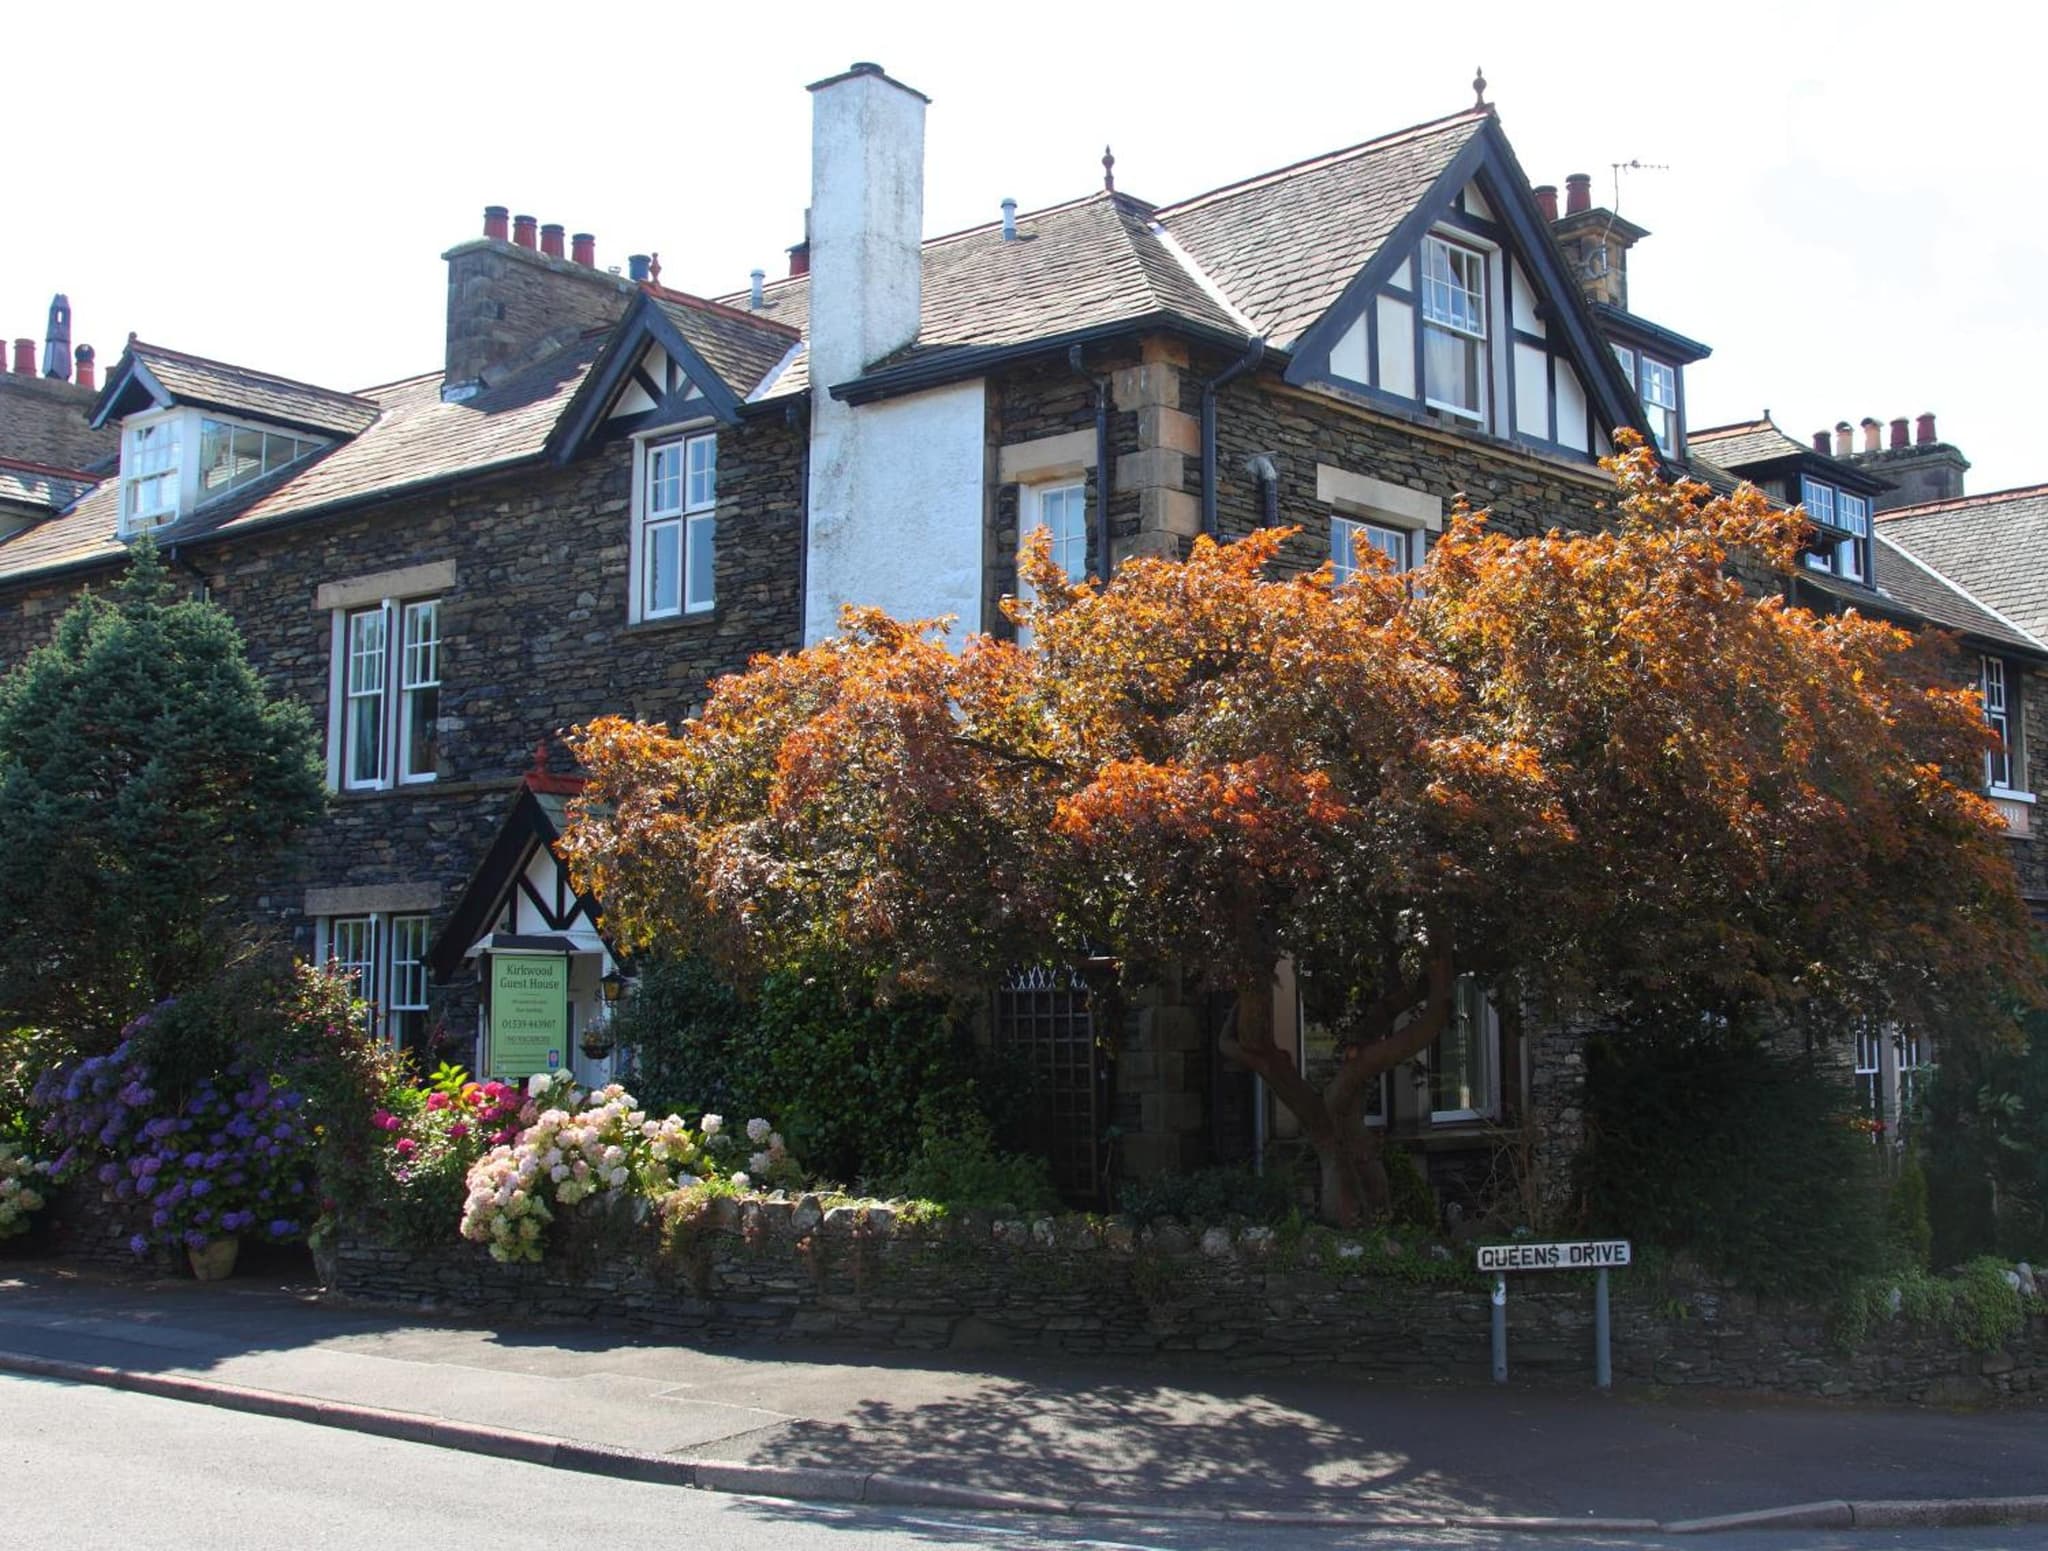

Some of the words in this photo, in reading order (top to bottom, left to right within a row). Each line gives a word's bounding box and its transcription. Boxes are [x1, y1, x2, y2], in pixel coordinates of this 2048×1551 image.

[506, 964, 553, 976] Kirkwood
[500, 977, 527, 989] Guest
[530, 978, 560, 991] House
[1481, 1247, 1560, 1267] QUEENS
[1569, 1244, 1626, 1264] DRIVE
